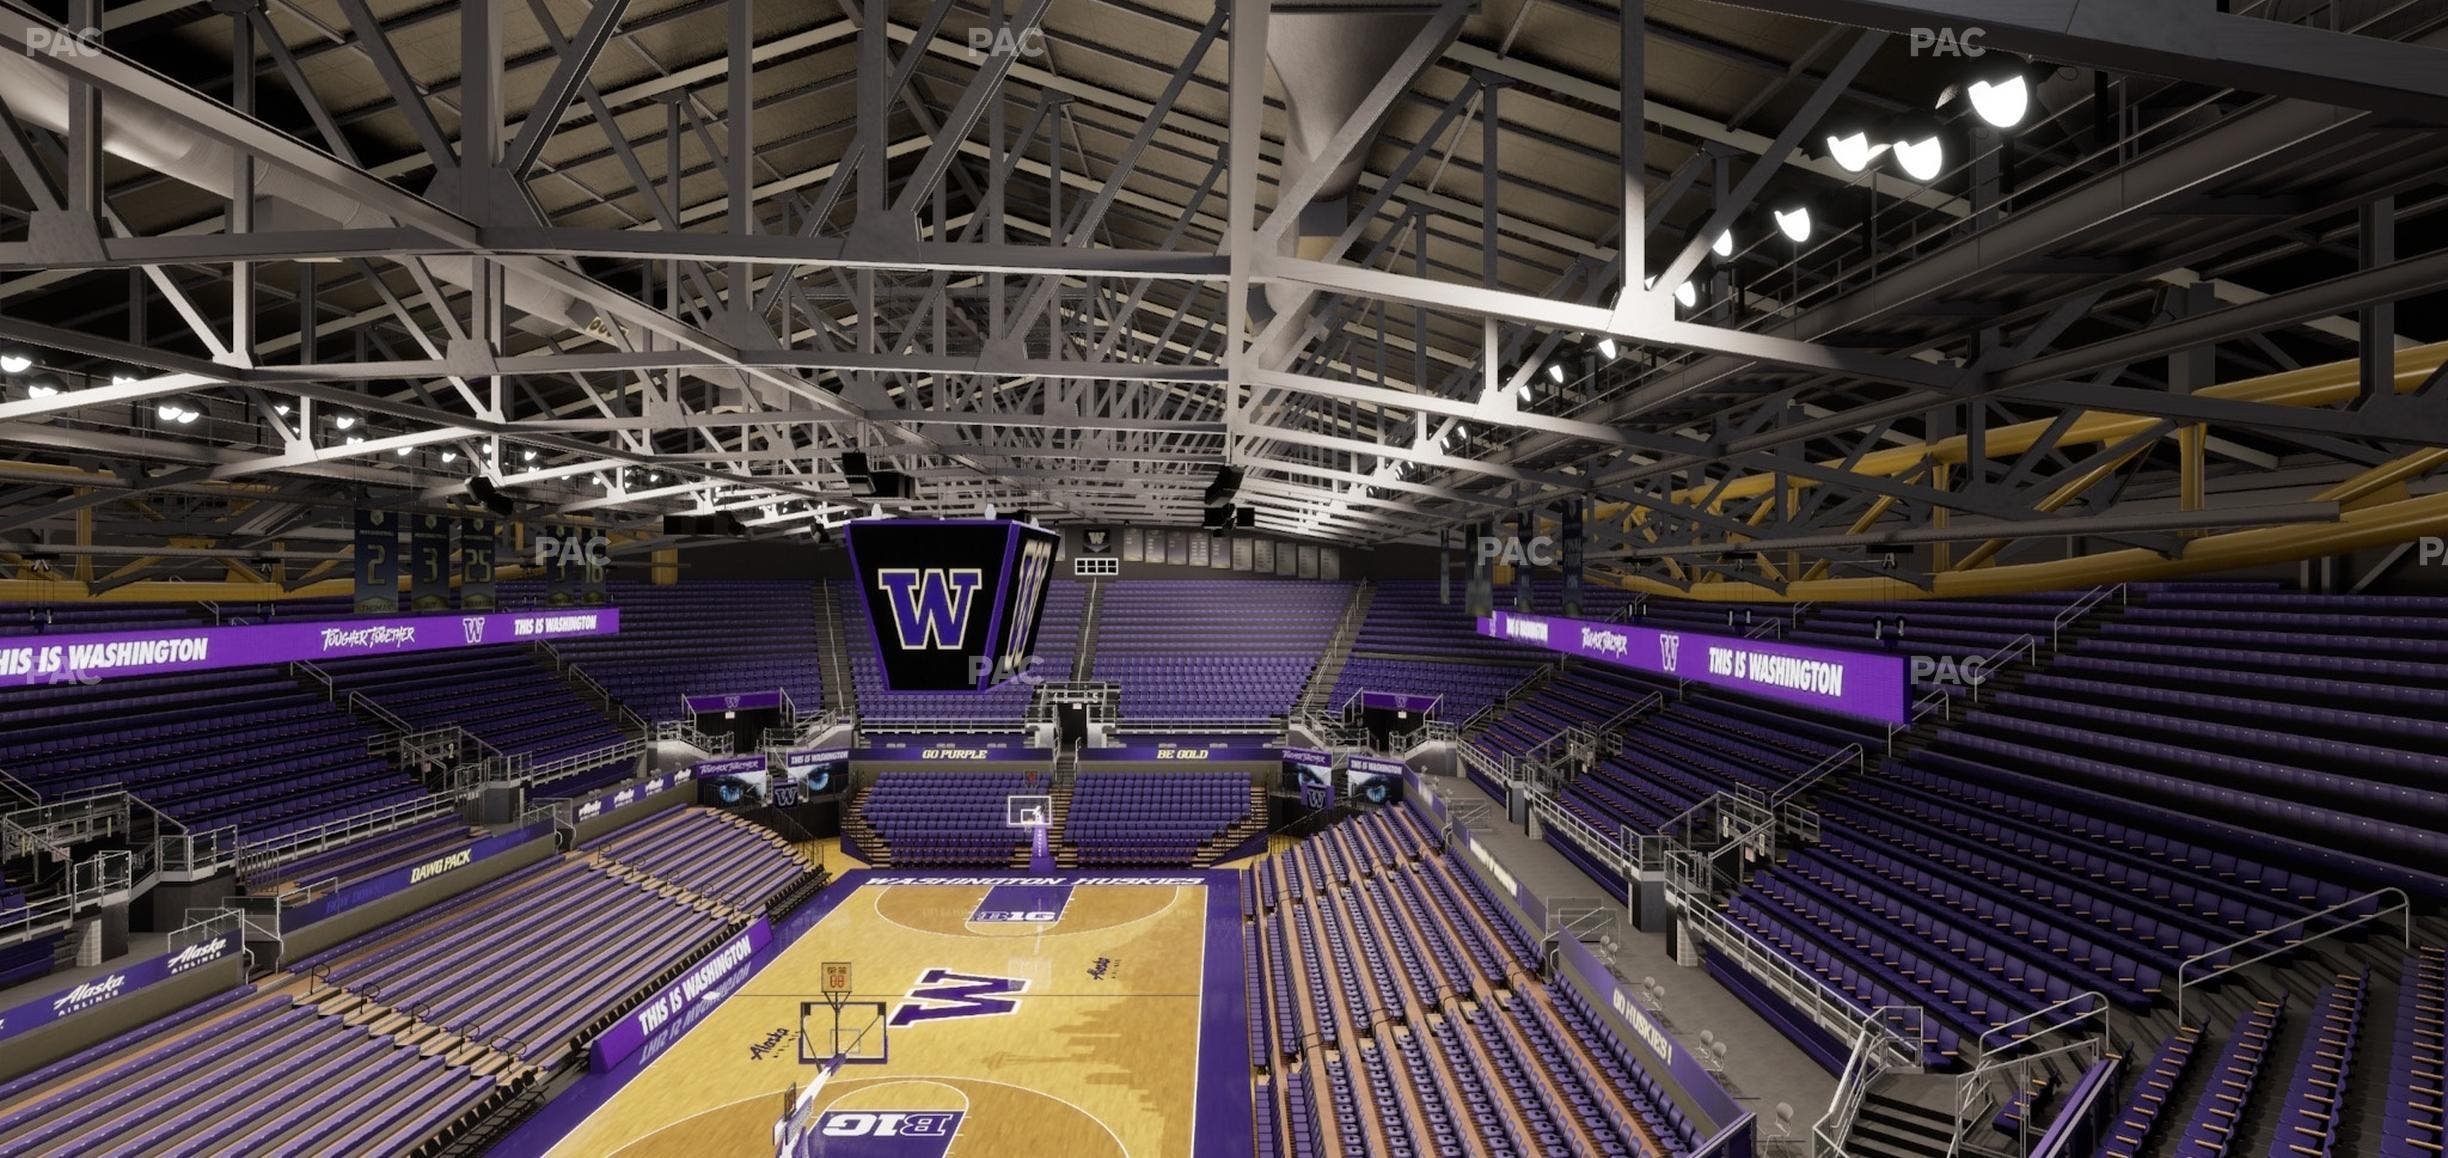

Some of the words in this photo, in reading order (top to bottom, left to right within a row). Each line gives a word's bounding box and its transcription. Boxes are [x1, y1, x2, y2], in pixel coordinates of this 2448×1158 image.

[367, 544, 386, 585] 2
[422, 547, 439, 584] 3
[464, 548, 492, 583] 25
[514, 619, 533, 635] THIS
[535, 618, 544, 634] IS
[545, 615, 597, 633] WASHINGTON
[877, 567, 982, 650] W
[462, 617, 485, 643] W
[38, 645, 62, 673] IS
[69, 638, 208, 670] WASHINGTON
[1660, 634, 1680, 672] W
[1708, 647, 1732, 676] THIS
[1734, 651, 1746, 678] IS
[1749, 652, 1844, 697] WASHINGTON
[922, 749, 939, 759] GO
[940, 749, 988, 760] PURPLE
[1157, 749, 1174, 759] BE
[1177, 749, 1209, 760] GOLD
[443, 848, 471, 872] PACK
[866, 877, 1067, 886] WASHINGTON
[1071, 877, 1206, 886] HUSKIES
[168, 937, 226, 968] Alaska
[171, 951, 221, 975] AIRLINES
[53, 974, 125, 1010] Alaska
[638, 996, 668, 1036] THIS
[669, 986, 683, 1015] IS
[682, 935, 752, 1002] WASHINGTON
[888, 967, 1033, 1028] W
[58, 990, 119, 1017] AIRLINES
